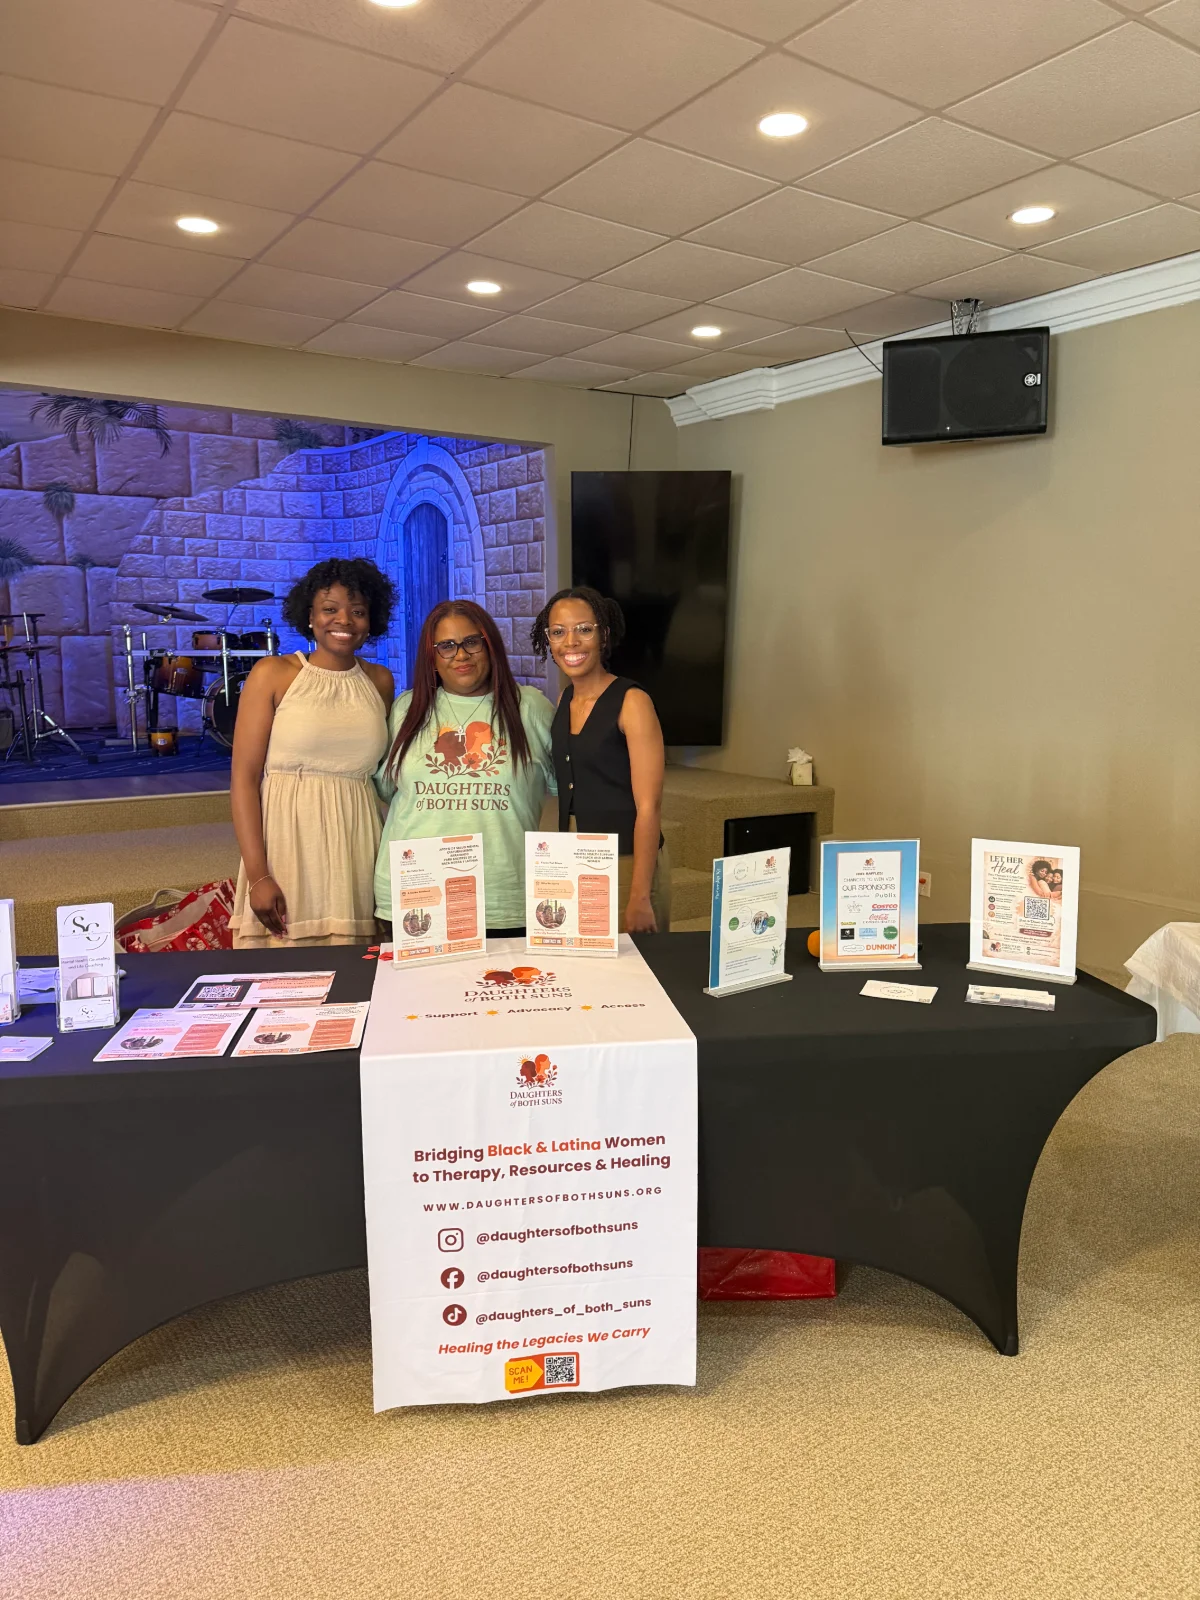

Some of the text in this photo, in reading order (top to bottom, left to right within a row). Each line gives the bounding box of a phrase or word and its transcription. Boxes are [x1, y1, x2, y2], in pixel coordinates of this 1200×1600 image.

[414, 781, 511, 796] DAUGHTERS
[416, 798, 509, 811] of BOTH SUNS
[990, 855, 1024, 865] LET HER
[991, 861, 1019, 875] Heal
[464, 987, 571, 997] DAUGHTERS
[425, 1011, 478, 1019] Support
[507, 1006, 572, 1014] Advocacy
[510, 1090, 562, 1099] DAUGHTERS
[510, 1100, 517, 1108] of
[414, 1135, 666, 1163] Bridging Black & Latina Women
[413, 1154, 671, 1183] to Therapy, Resources & Healing
[423, 1186, 663, 1212] WWW.DAUGHTERSOFBOTHSUNS.ORG
[476, 1220, 638, 1245] @daughtersofbothsuns
[477, 1259, 633, 1283] @daughtersofbothsuns
[475, 1297, 652, 1325] @daughters_of_both_suns
[438, 1326, 651, 1355] Healing the Legacies We Carry
[508, 1365, 533, 1376] SCAN
[513, 1375, 529, 1385] ME!
